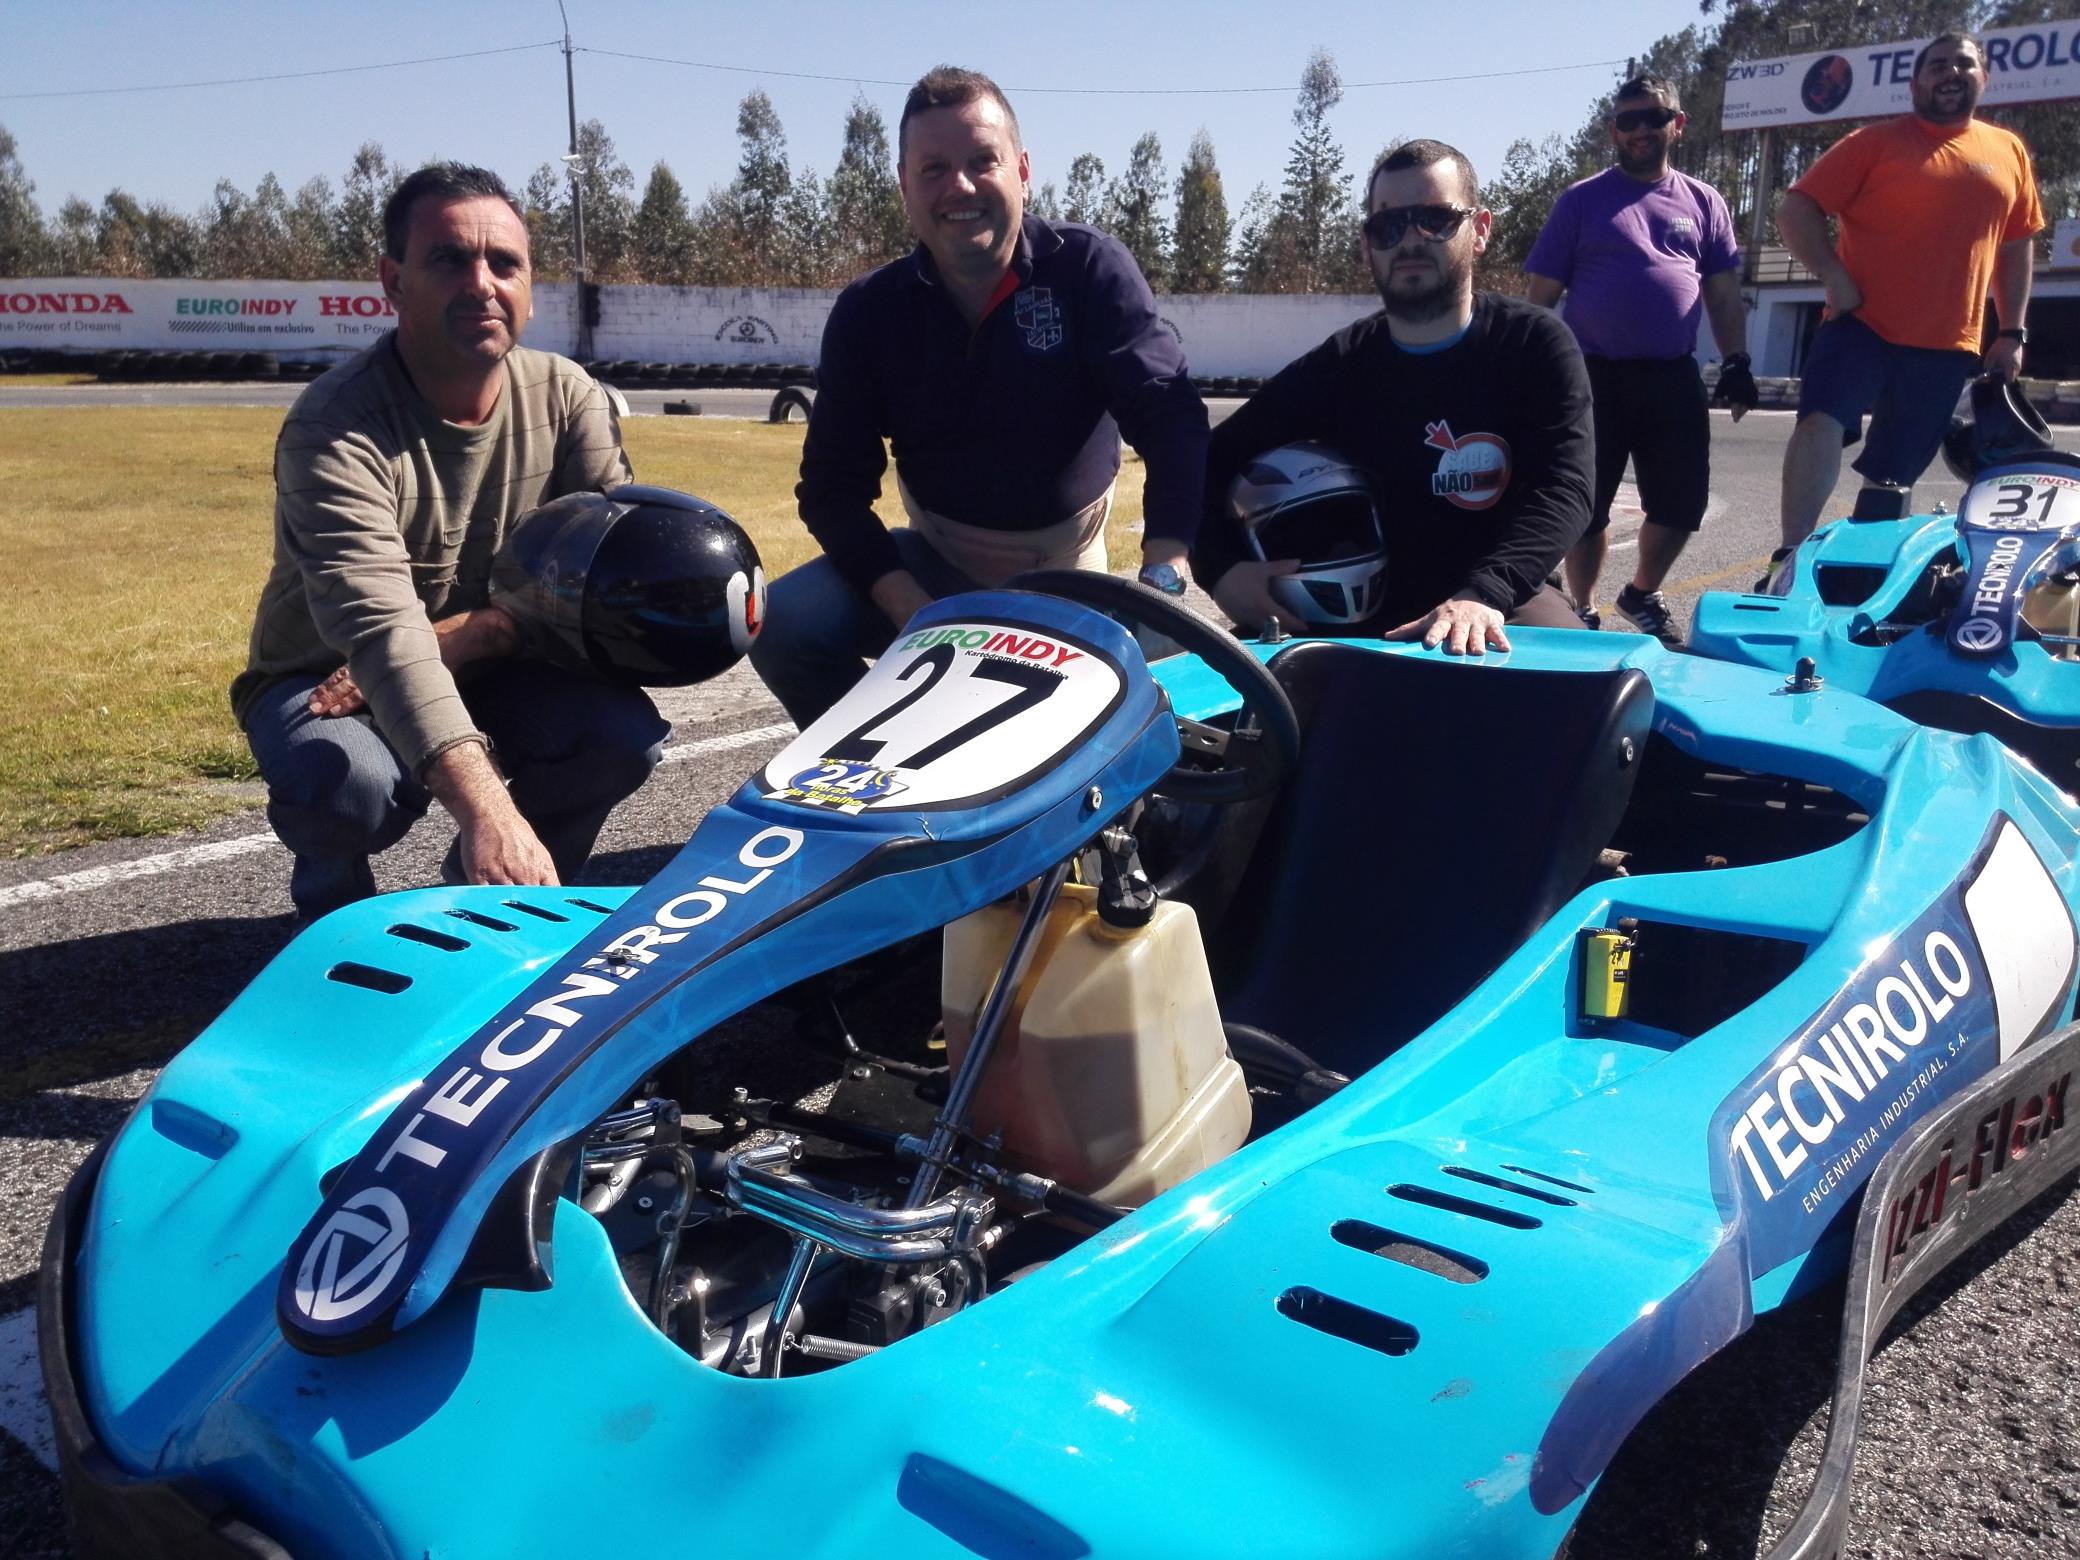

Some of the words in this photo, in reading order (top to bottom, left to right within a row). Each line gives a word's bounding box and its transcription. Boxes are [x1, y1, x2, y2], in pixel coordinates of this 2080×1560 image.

[1727, 63, 1784, 81] ZW3D
[1868, 32, 2080, 86] TEROL
[176, 298, 298, 316] EUROINDY
[59, 321, 71, 332] of
[74, 321, 121, 333] Dreams
[274, 322, 314, 335] exclusivo
[336, 323, 360, 334] The
[363, 324, 391, 334] Pow
[1433, 470, 1473, 495] NÃO
[1989, 484, 2058, 522] 31
[1971, 537, 2024, 616] TECNIROLO
[899, 628, 1084, 668] EUROINDY
[819, 642, 1064, 771] 27
[801, 764, 879, 793] 24
[375, 826, 805, 1174] TECNIROLO
[1730, 930, 1972, 1202] TECNIROLO
[1802, 1126, 1880, 1214] ENGENHARIA
[1879, 1058, 1949, 1131] INDUSTRIAL,
[1948, 1033, 1970, 1058] S.A.
